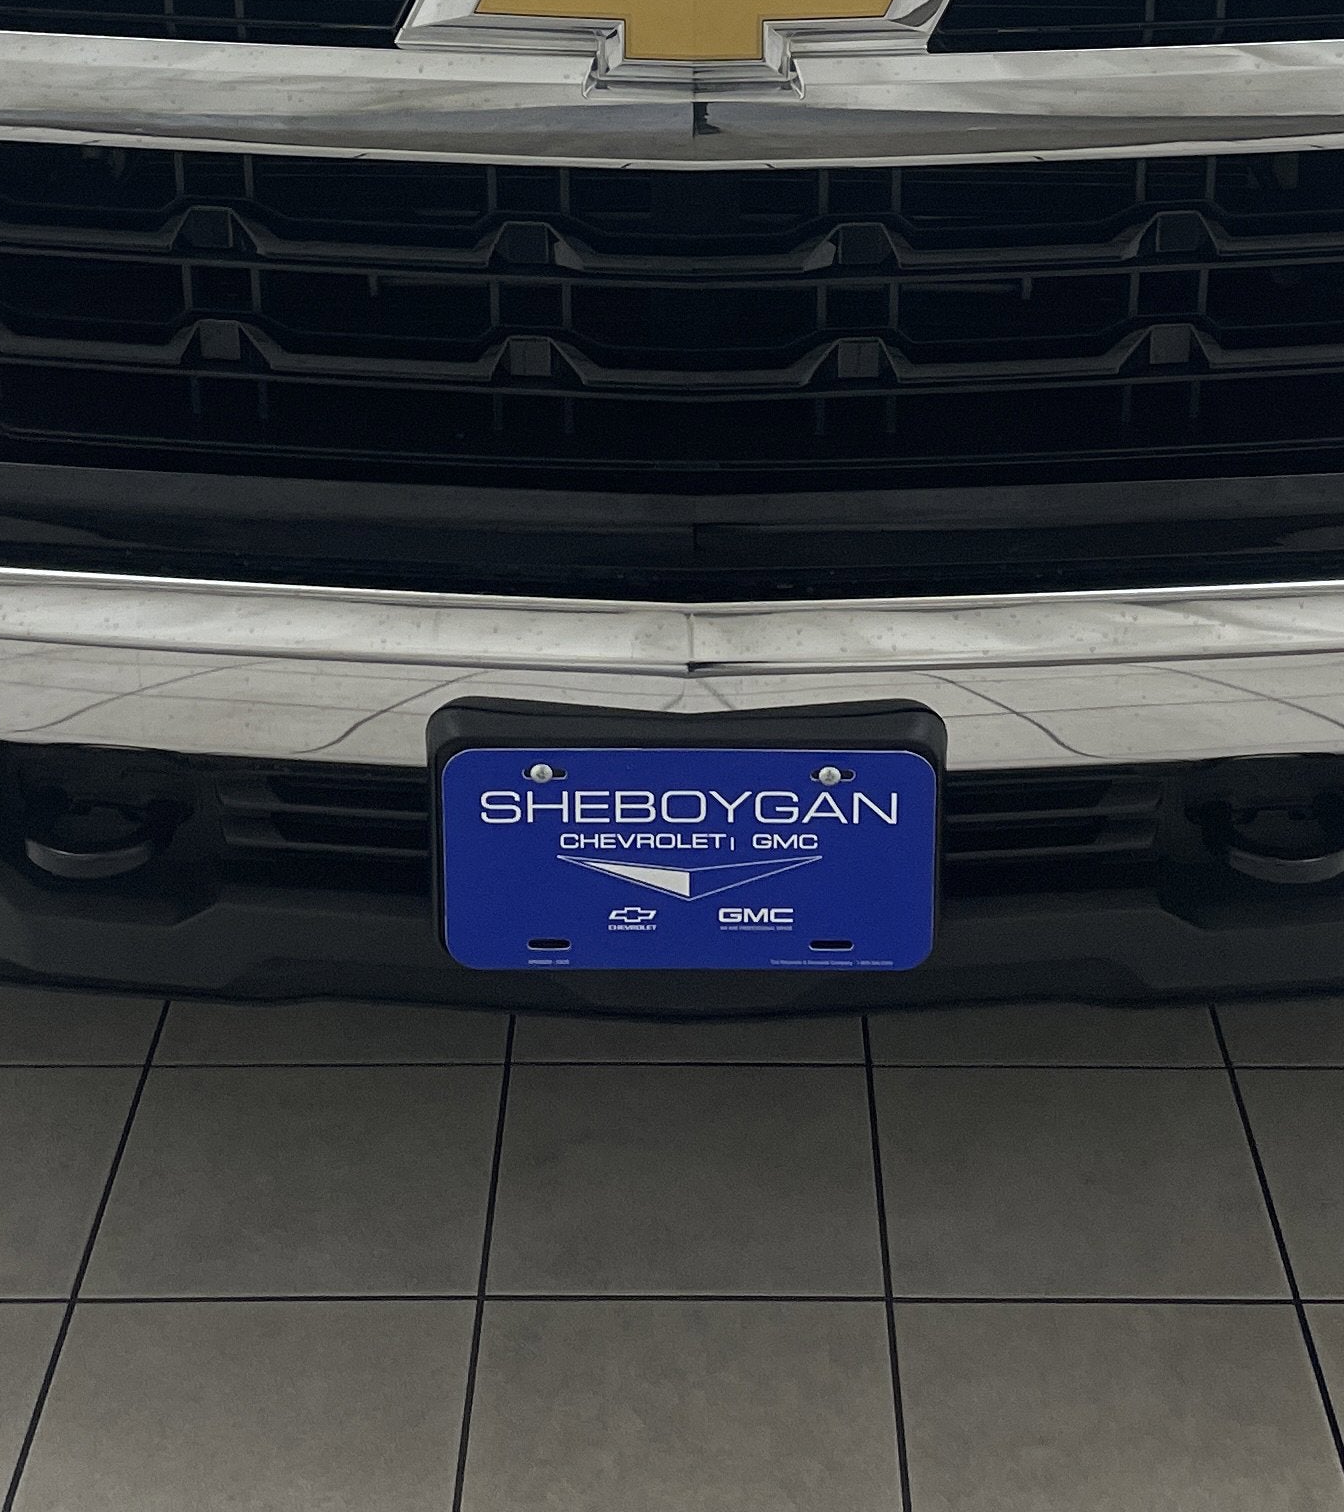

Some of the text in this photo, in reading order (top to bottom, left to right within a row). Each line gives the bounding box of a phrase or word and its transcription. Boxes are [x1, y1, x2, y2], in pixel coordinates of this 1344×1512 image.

[479, 790, 898, 825] SHEBOYGAN
[751, 833, 819, 850] GMC
[718, 907, 794, 923] GMC
